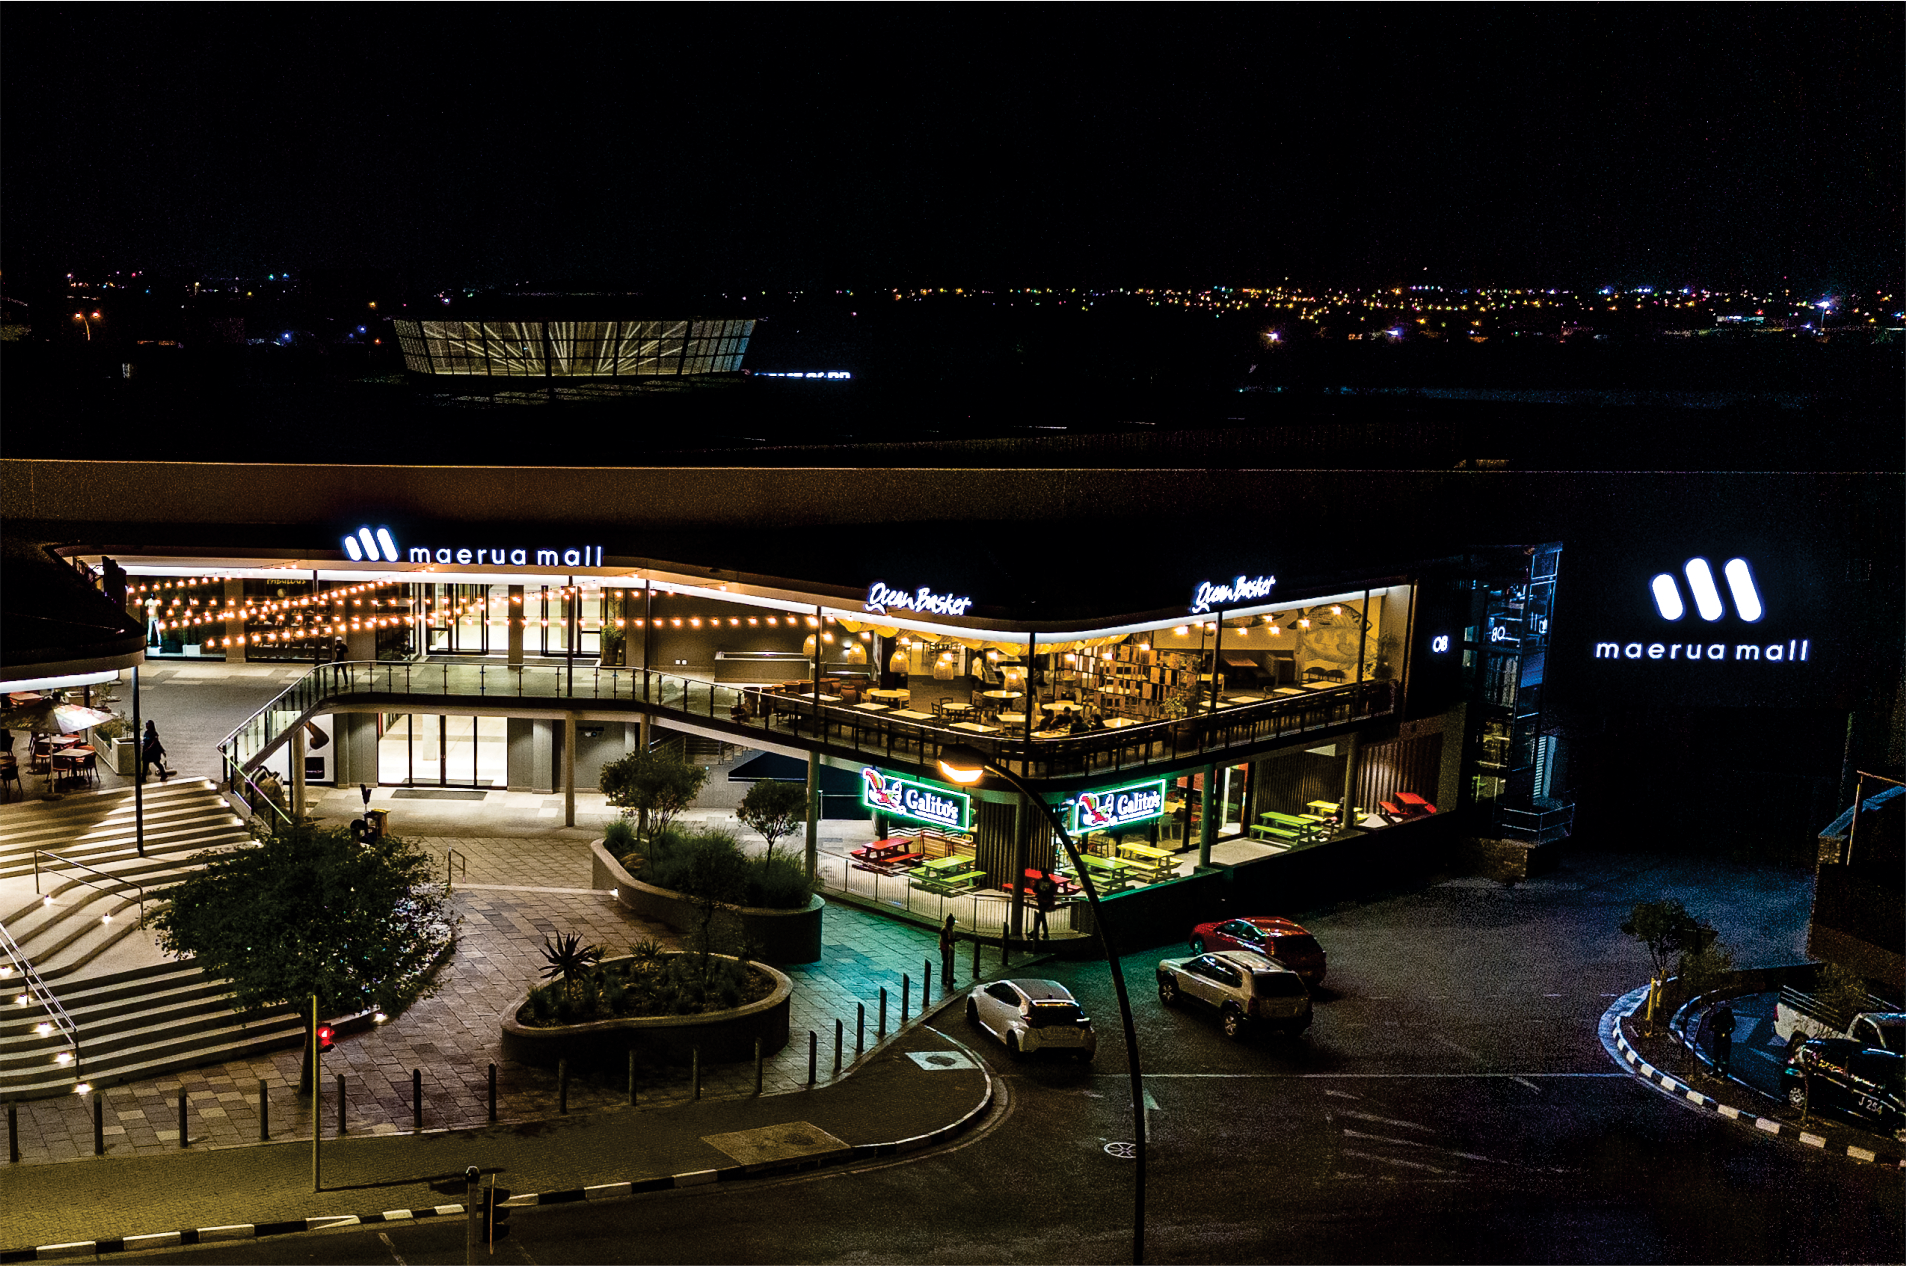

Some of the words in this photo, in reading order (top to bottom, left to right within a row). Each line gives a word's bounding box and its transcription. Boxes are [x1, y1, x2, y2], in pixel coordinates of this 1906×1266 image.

[409, 546, 527, 566] maerua
[537, 545, 603, 567] mall
[865, 582, 915, 615] Ocean
[914, 587, 972, 616] Basket
[1192, 581, 1234, 613] Ocean
[1233, 575, 1277, 602] Basket
[1595, 642, 1726, 660] maerua
[1735, 639, 1809, 661] mall
[905, 788, 959, 820] Galito's
[1117, 791, 1161, 816] Galito's
